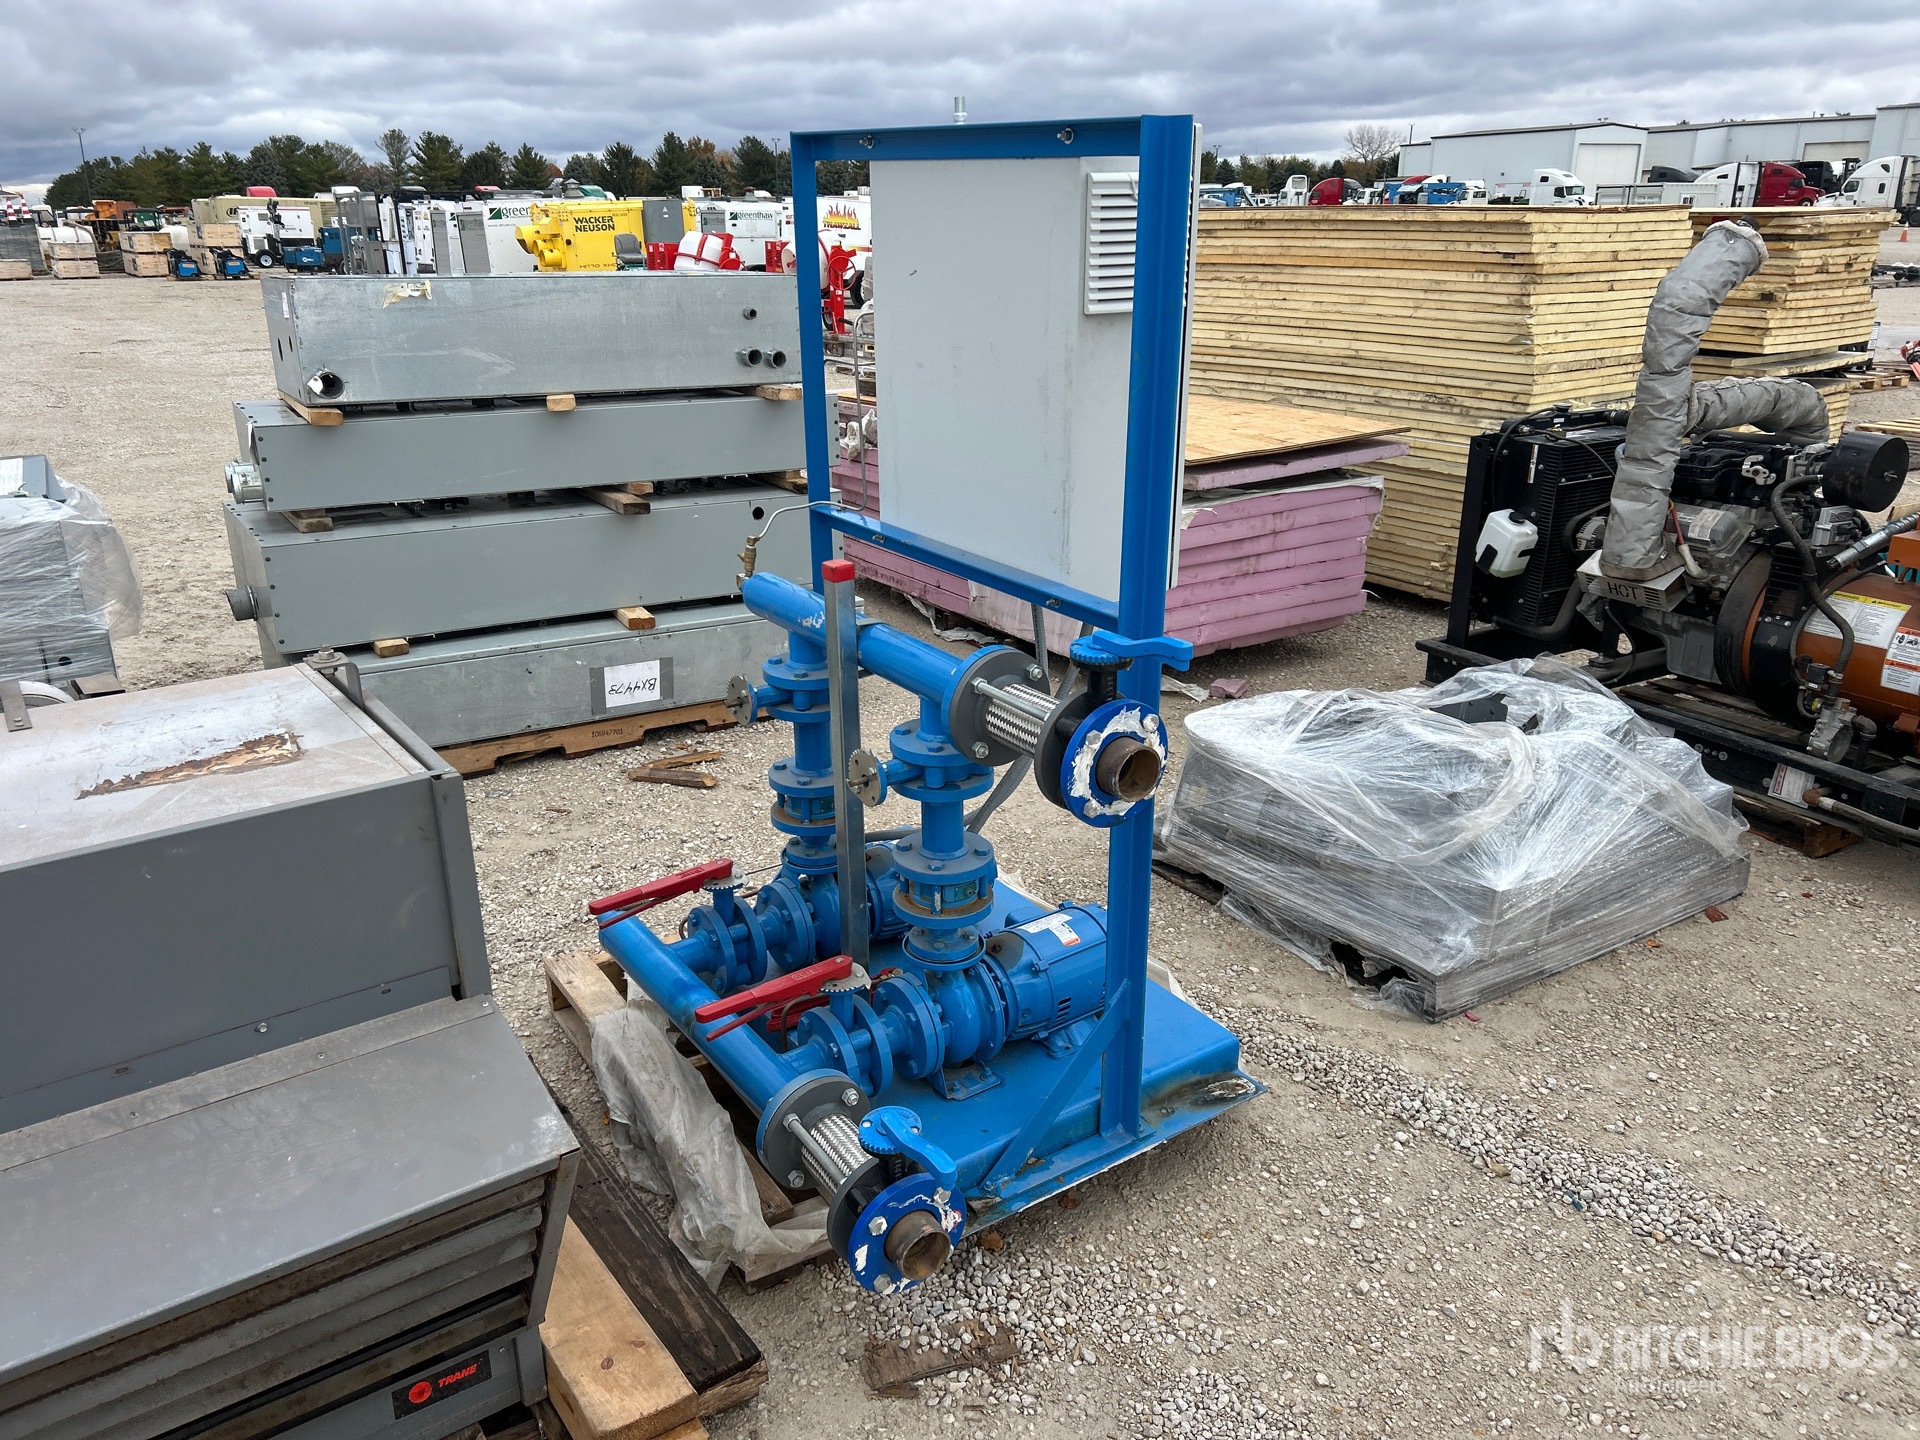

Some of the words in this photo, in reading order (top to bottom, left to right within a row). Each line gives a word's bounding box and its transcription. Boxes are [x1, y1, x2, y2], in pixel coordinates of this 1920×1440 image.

[573, 216, 614, 225] WACKER
[575, 224, 615, 233] NEUSON
[1607, 581, 1637, 600] HOT
[608, 677, 657, 695] BX4473
[438, 1364, 478, 1387] TRANE
